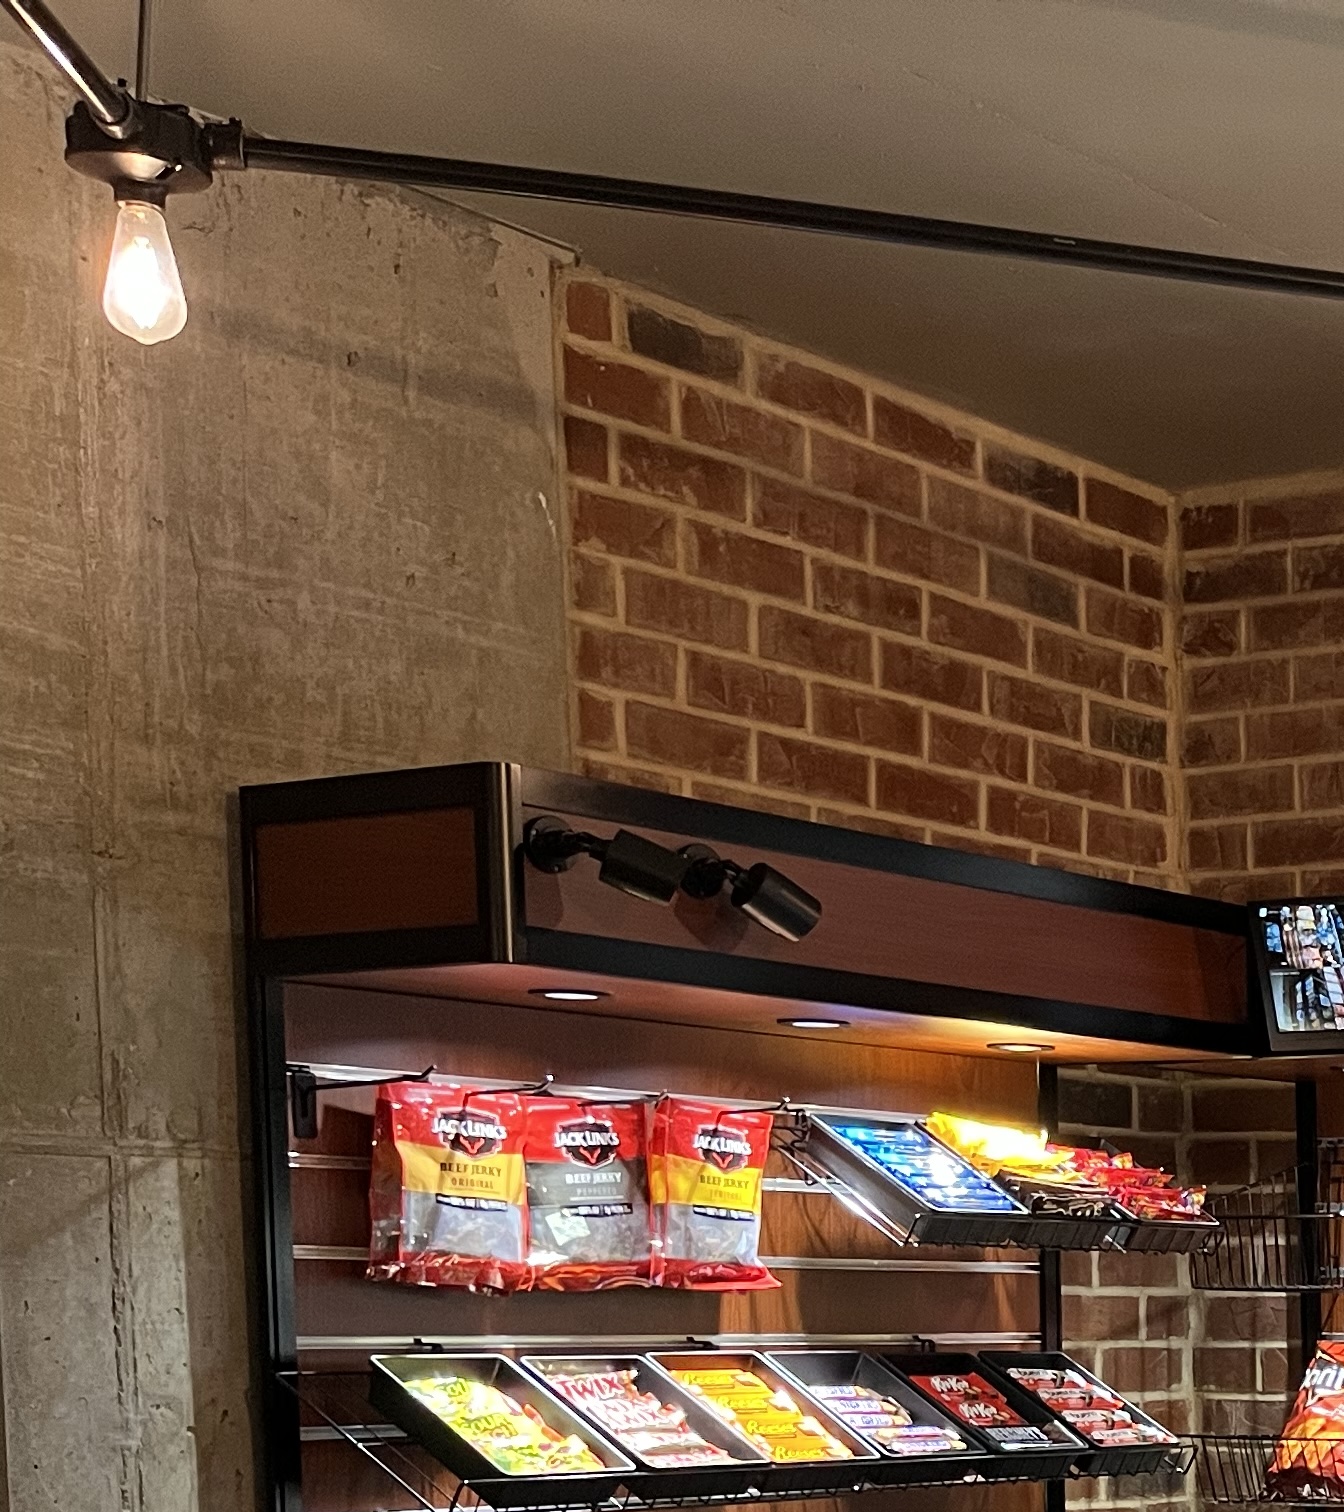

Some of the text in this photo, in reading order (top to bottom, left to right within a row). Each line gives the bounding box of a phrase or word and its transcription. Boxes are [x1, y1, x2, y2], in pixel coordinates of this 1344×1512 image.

[440, 1162, 502, 1177] BEEF JERKY
[566, 1172, 621, 1184] BEEF JERKY
[700, 1175, 749, 1189] BEEF JERKY
[559, 1376, 623, 1400] TWIX
